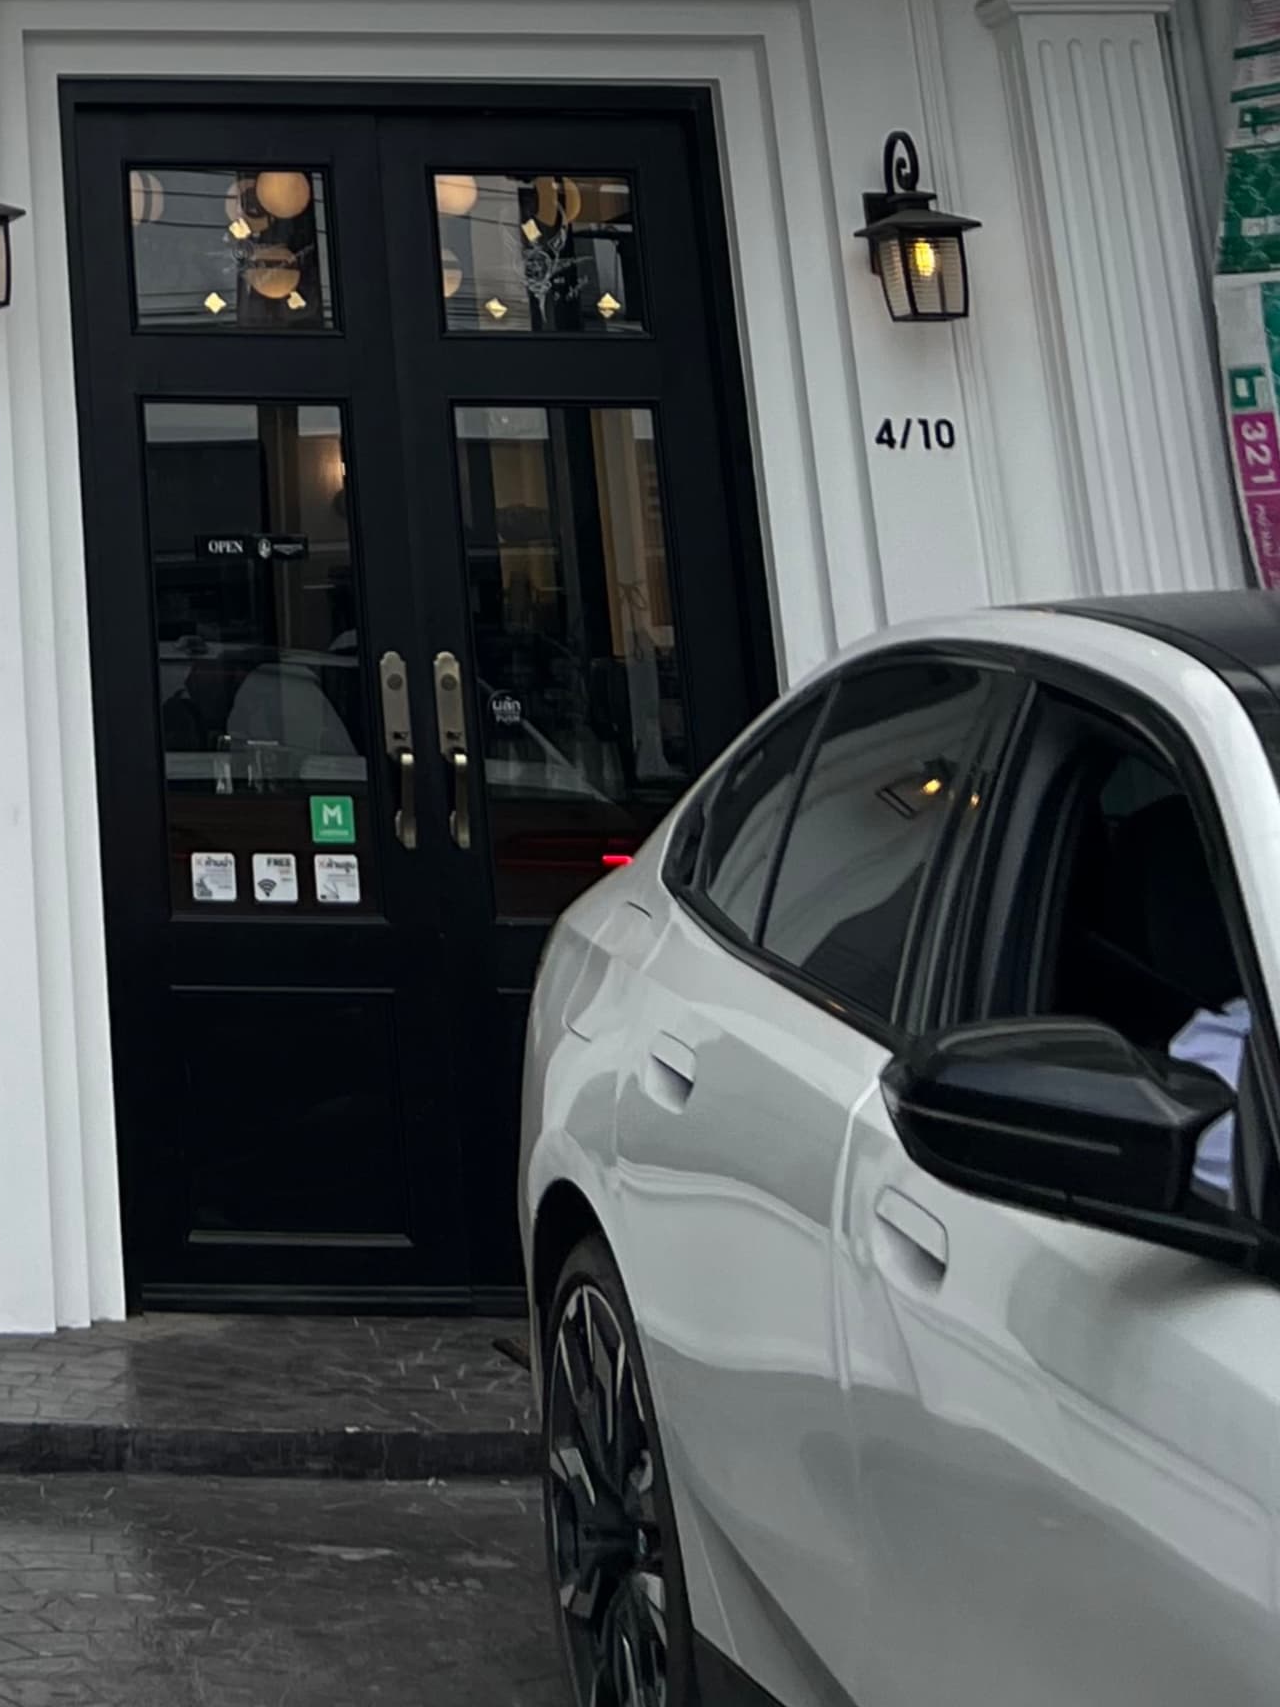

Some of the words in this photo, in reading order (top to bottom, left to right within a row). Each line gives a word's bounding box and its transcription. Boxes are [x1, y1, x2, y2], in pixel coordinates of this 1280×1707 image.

[874, 417, 956, 450] 4/10
[207, 539, 244, 554] OPEN
[267, 857, 292, 868] FREE
